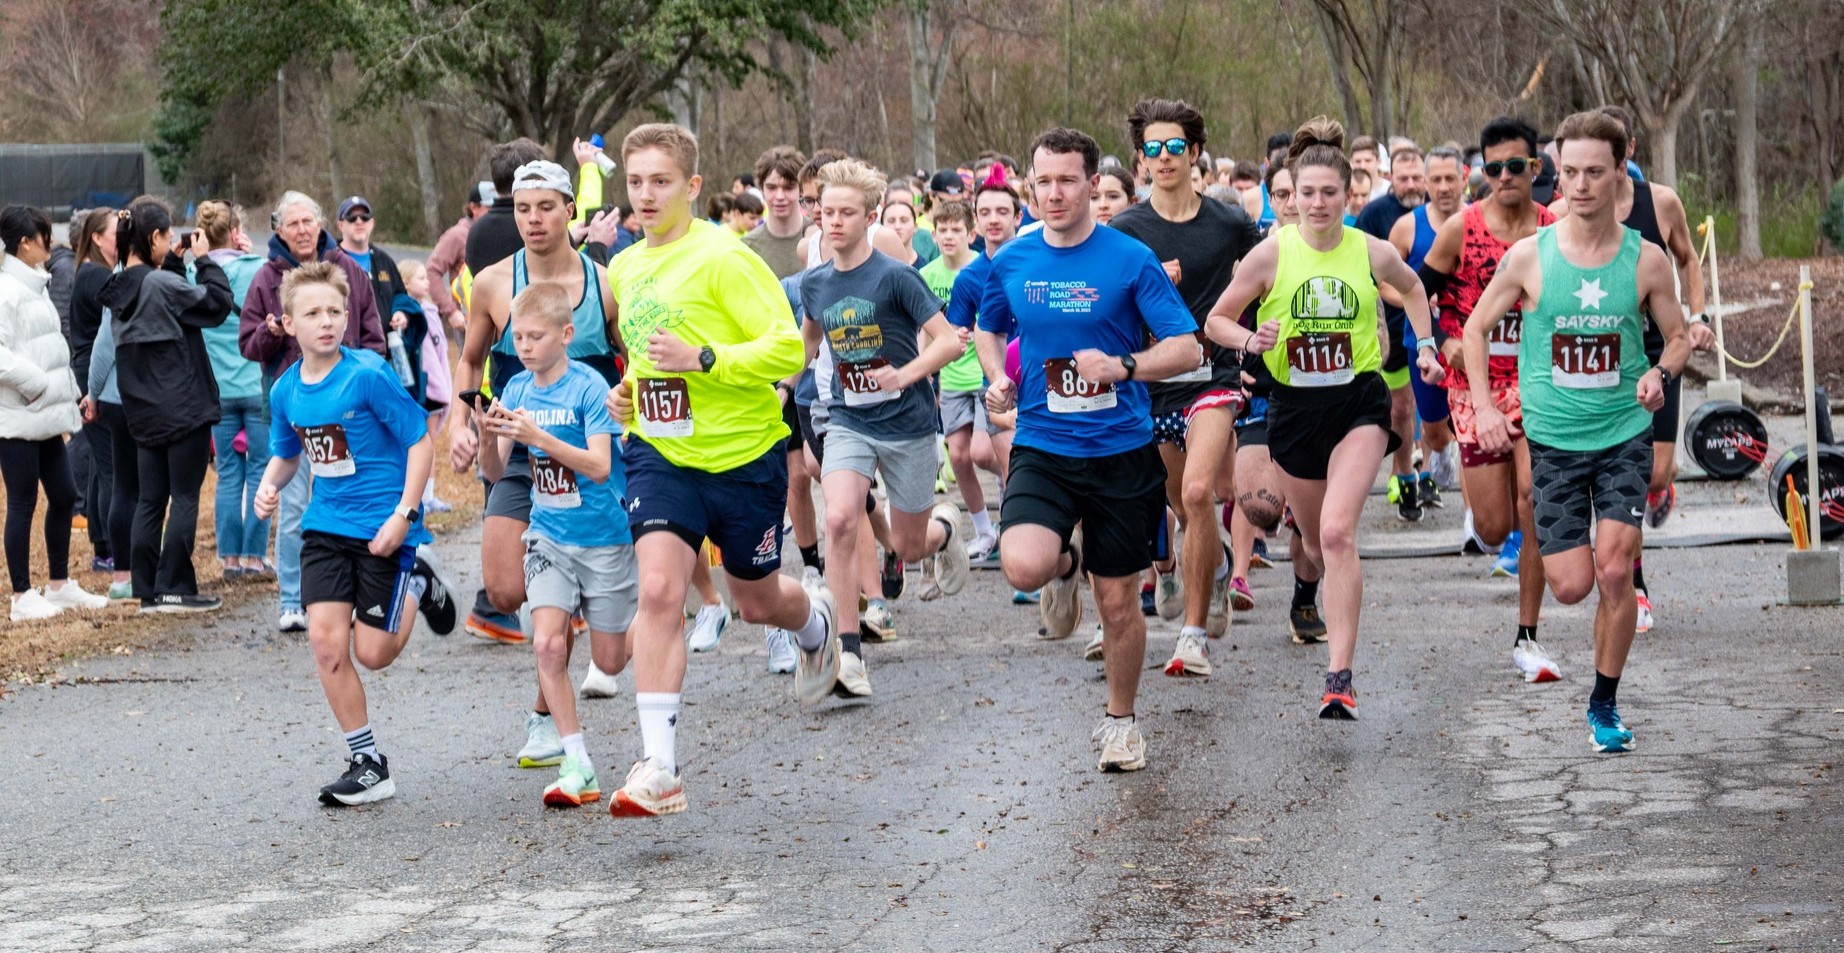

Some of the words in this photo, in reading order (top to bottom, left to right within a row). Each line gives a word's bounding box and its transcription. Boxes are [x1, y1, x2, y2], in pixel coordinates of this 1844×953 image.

[1049, 291, 1071, 299] ROAD
[1050, 281, 1086, 289] TOBACCO
[1048, 300, 1092, 309] MARATHON
[1312, 320, 1332, 330] Run
[1488, 319, 1523, 342] 14
[1554, 314, 1625, 329] SAYSKY
[1296, 343, 1346, 371] 1116
[1561, 345, 1611, 372] 1141
[641, 390, 683, 419] 1157
[304, 435, 338, 462] 852
[532, 466, 570, 493] 1284
